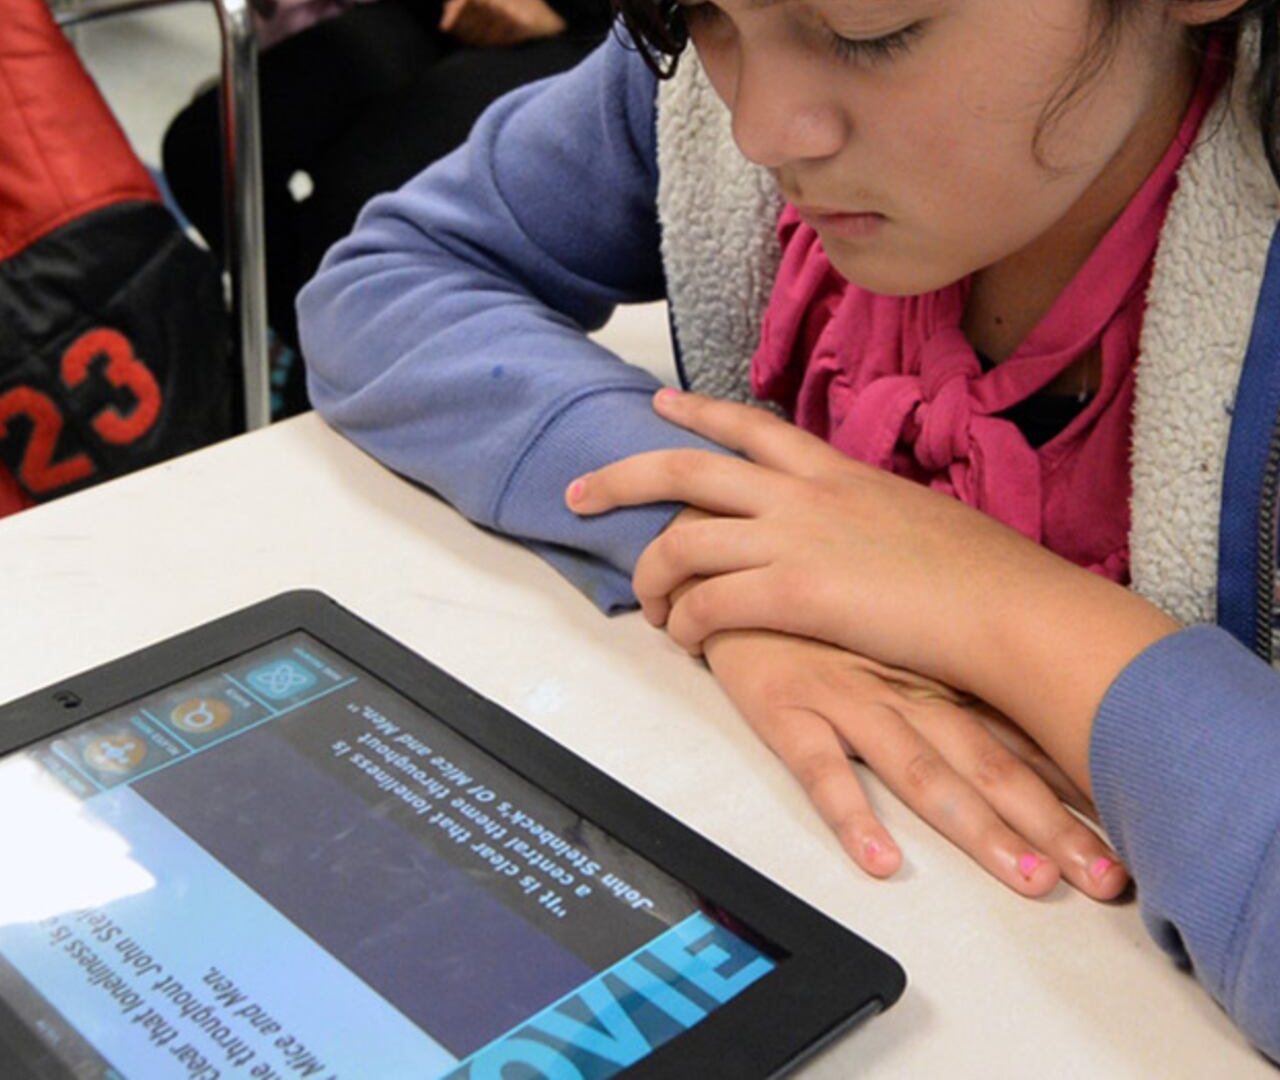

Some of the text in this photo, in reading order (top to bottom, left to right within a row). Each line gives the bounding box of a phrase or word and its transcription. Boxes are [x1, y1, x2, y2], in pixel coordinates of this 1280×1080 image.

[330, 740, 351, 758] is
[396, 733, 433, 757] and
[349, 753, 431, 816] loneliness
[430, 755, 473, 788] Mice
[467, 784, 497, 803] Of
[357, 732, 592, 899] a central theme throughout
[428, 811, 472, 844] that
[470, 842, 520, 876] clear
[497, 802, 602, 878] Steinbeck's
[519, 875, 540, 897] is
[601, 872, 655, 910] John
[49, 926, 71, 946] is
[115, 936, 162, 977] John
[65, 940, 145, 1014] loneliness
[202, 966, 249, 1009] Men.
[131, 1007, 179, 1048] that
[151, 975, 256, 1068] throughout
[238, 1003, 282, 1037] and
[275, 1034, 326, 1079] Mice
